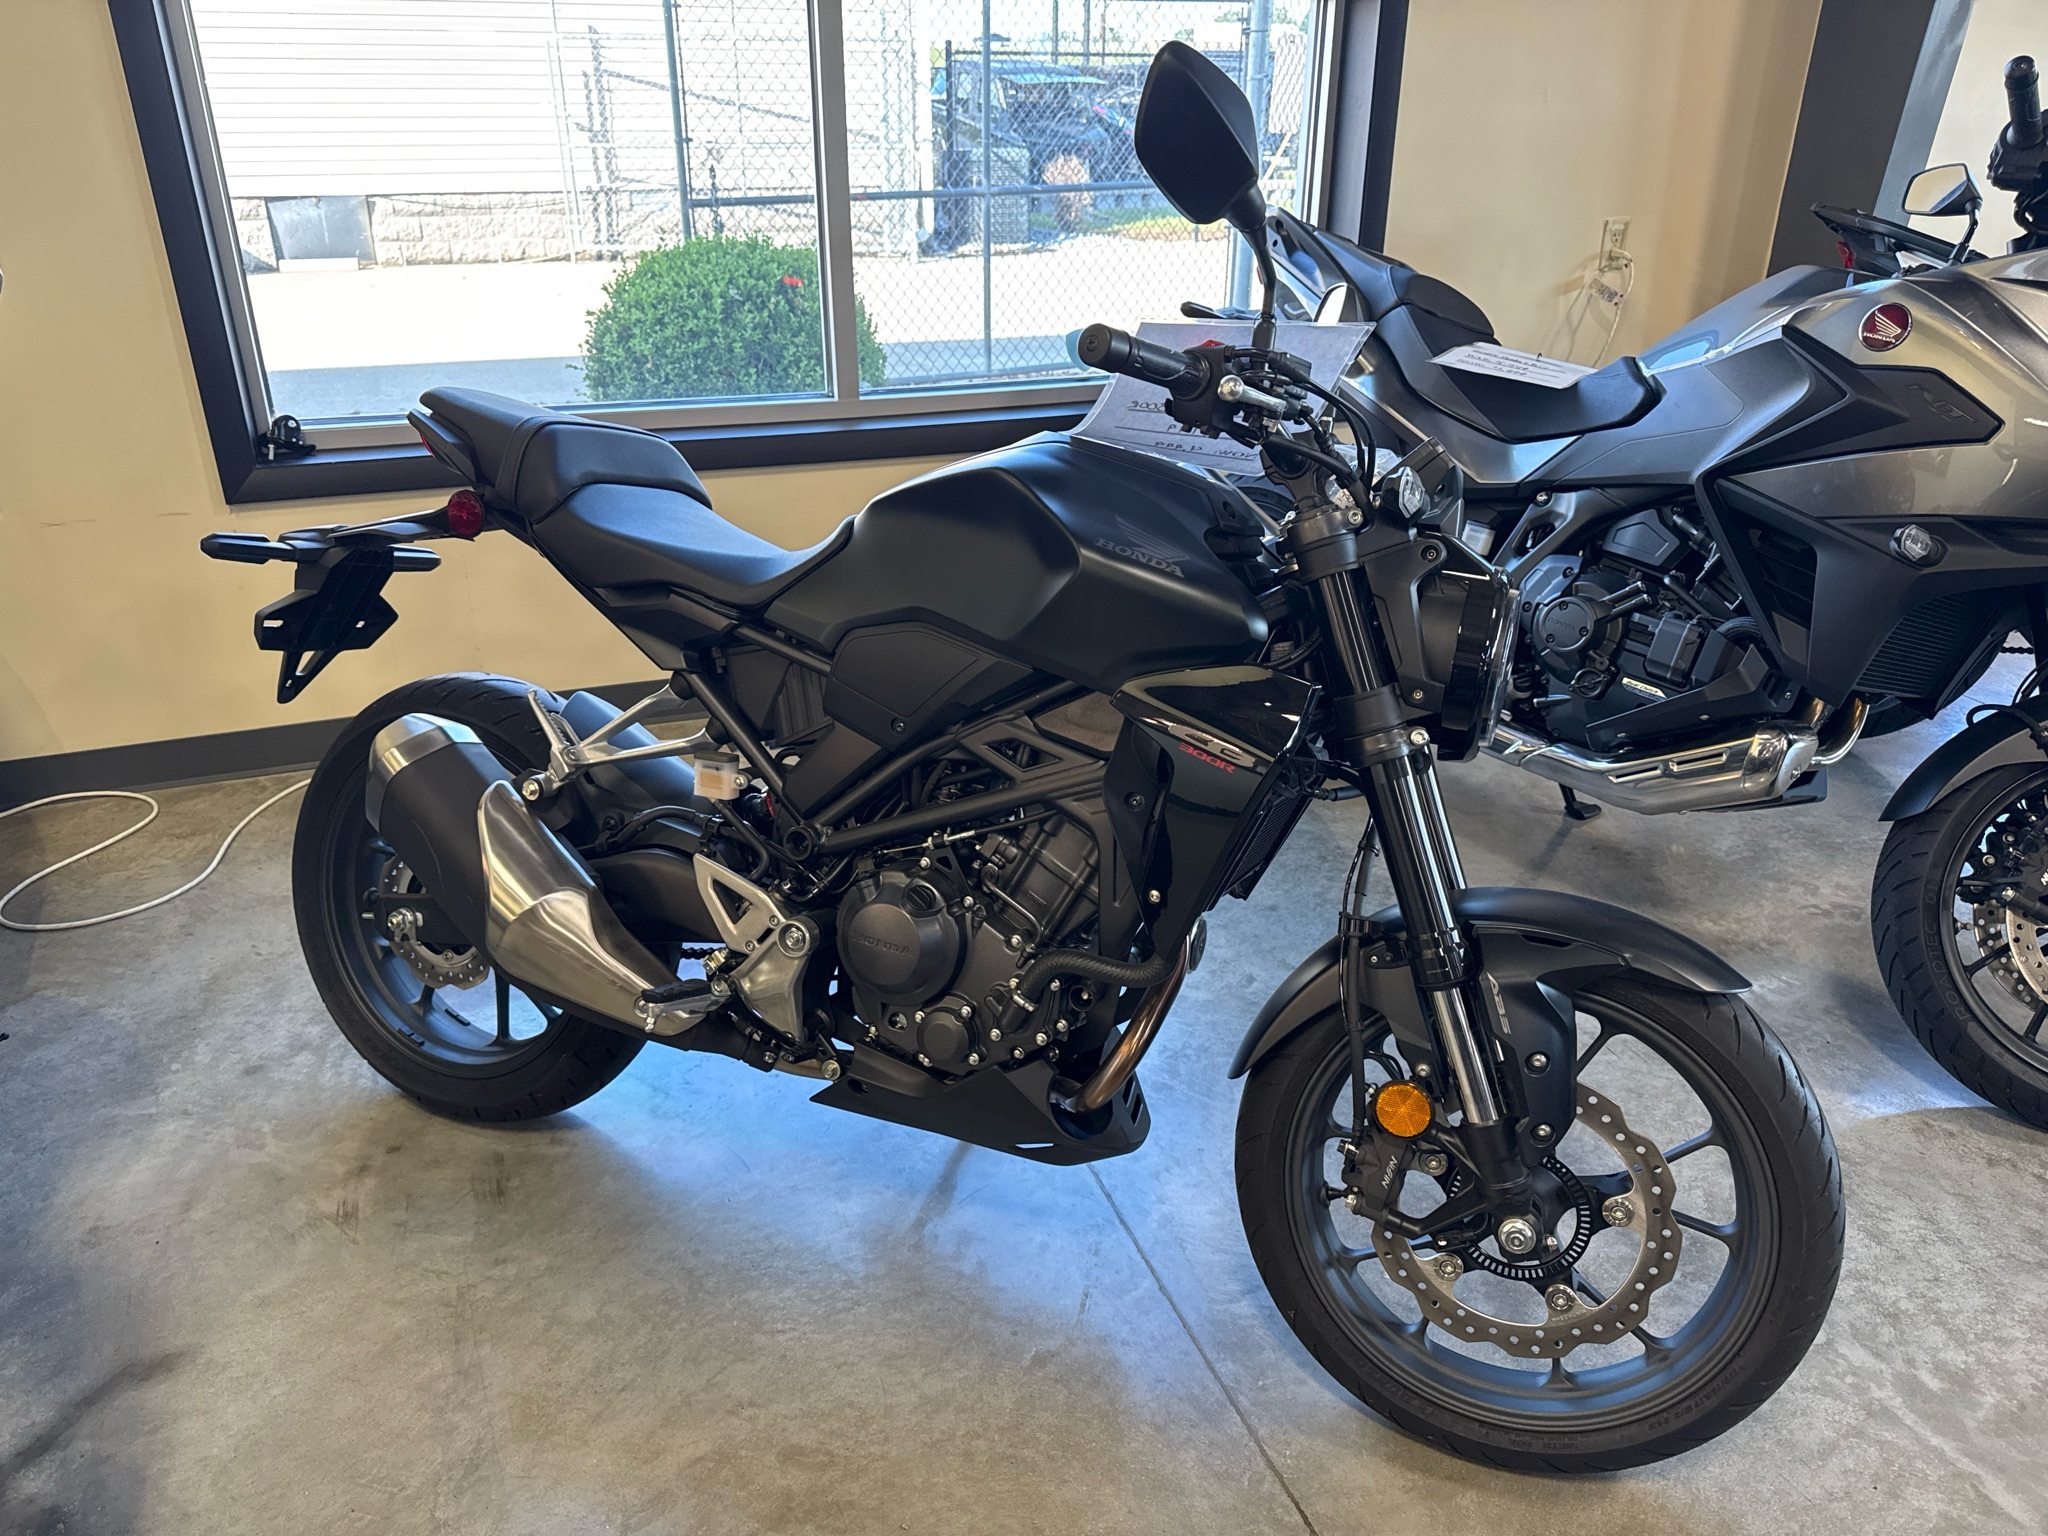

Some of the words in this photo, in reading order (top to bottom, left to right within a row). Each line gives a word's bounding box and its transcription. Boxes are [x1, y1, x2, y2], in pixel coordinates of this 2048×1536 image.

[1863, 332, 1896, 343] HONDA
[1095, 537, 1184, 578] HONDA
[1179, 741, 1236, 774] 300R
[852, 931, 914, 958] HONDA
[1925, 922, 1971, 1021] ROADTEC
[1486, 971, 1512, 1035] ABS
